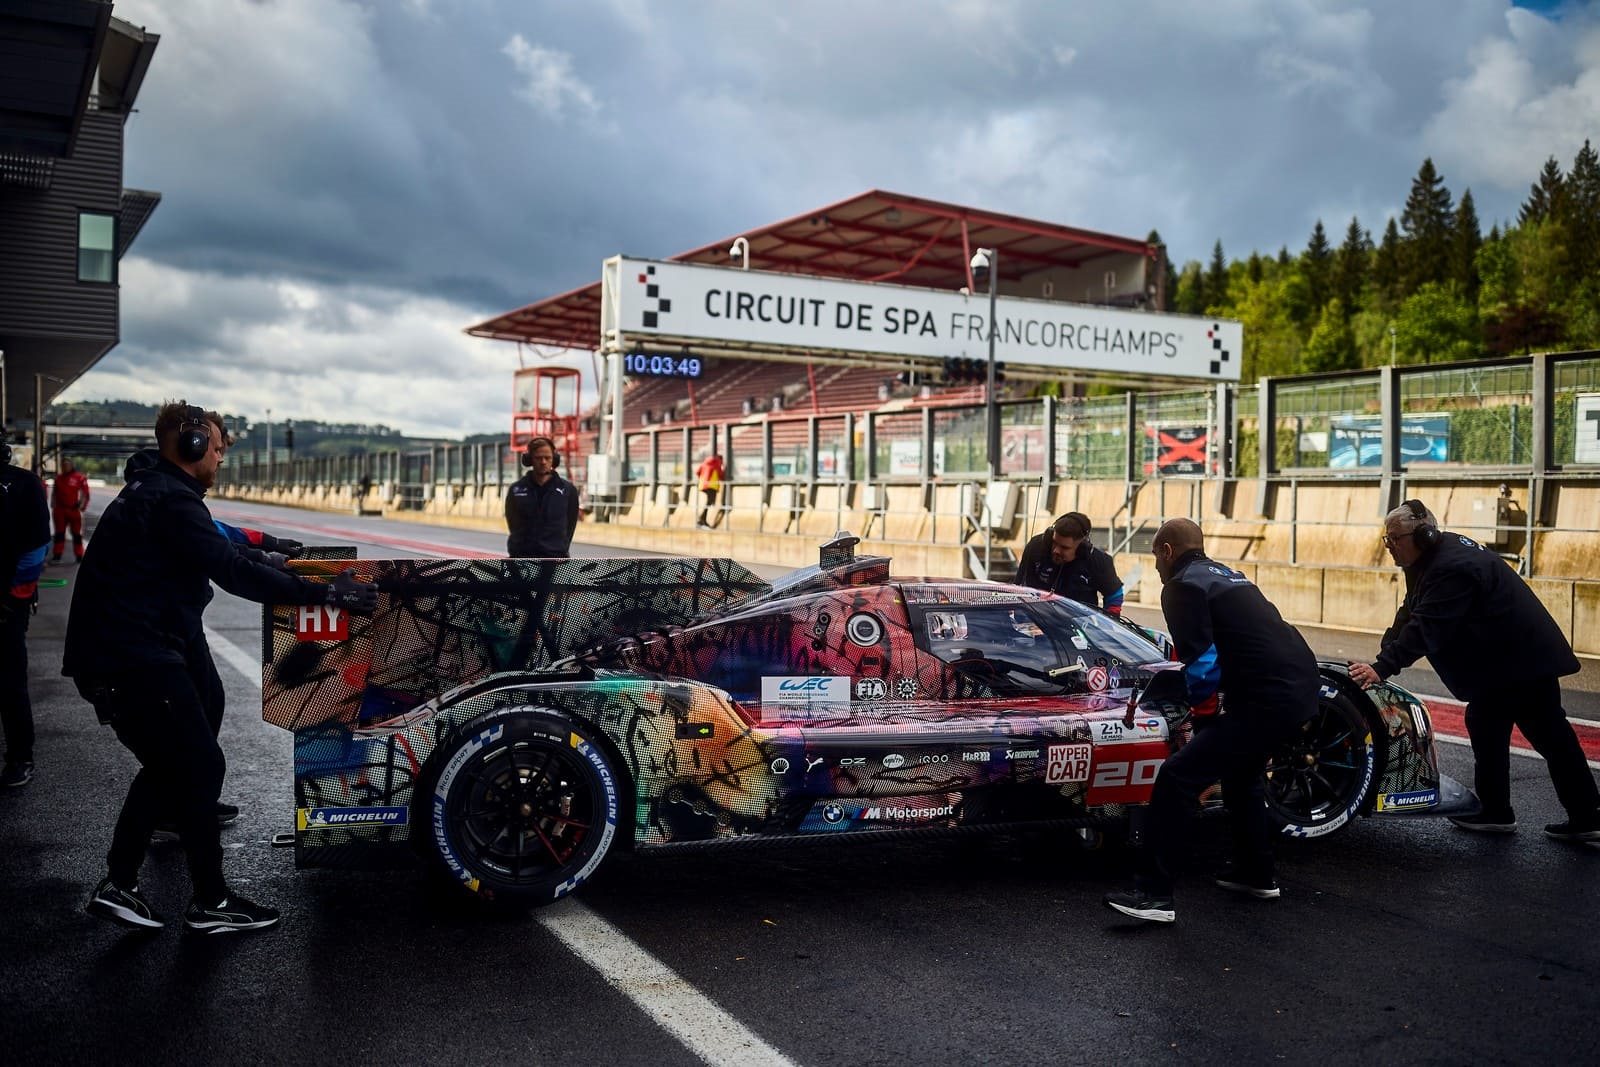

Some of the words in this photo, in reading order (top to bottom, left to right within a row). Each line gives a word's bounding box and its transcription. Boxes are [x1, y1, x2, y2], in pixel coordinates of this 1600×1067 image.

[705, 289, 825, 327] CIRCUIT
[836, 301, 873, 331] DE
[884, 307, 938, 337] SPA
[951, 313, 1178, 358] FRANCORCHAMPS
[625, 354, 701, 377] 10:03:49
[299, 604, 341, 633] HY
[780, 678, 832, 690] WEC
[1091, 670, 1105, 688] E
[857, 681, 884, 698] FIA
[1051, 747, 1089, 761] HYPER
[1048, 760, 1088, 780] CAR
[1093, 759, 1166, 787] 20
[588, 752, 617, 819] MICHELIN
[1350, 756, 1374, 815] MICHELIN
[1397, 794, 1435, 805] MICHELIN
[329, 812, 399, 823] MICHELIN
[886, 805, 953, 820] Motorsport
[433, 801, 462, 872] MICHELIN
